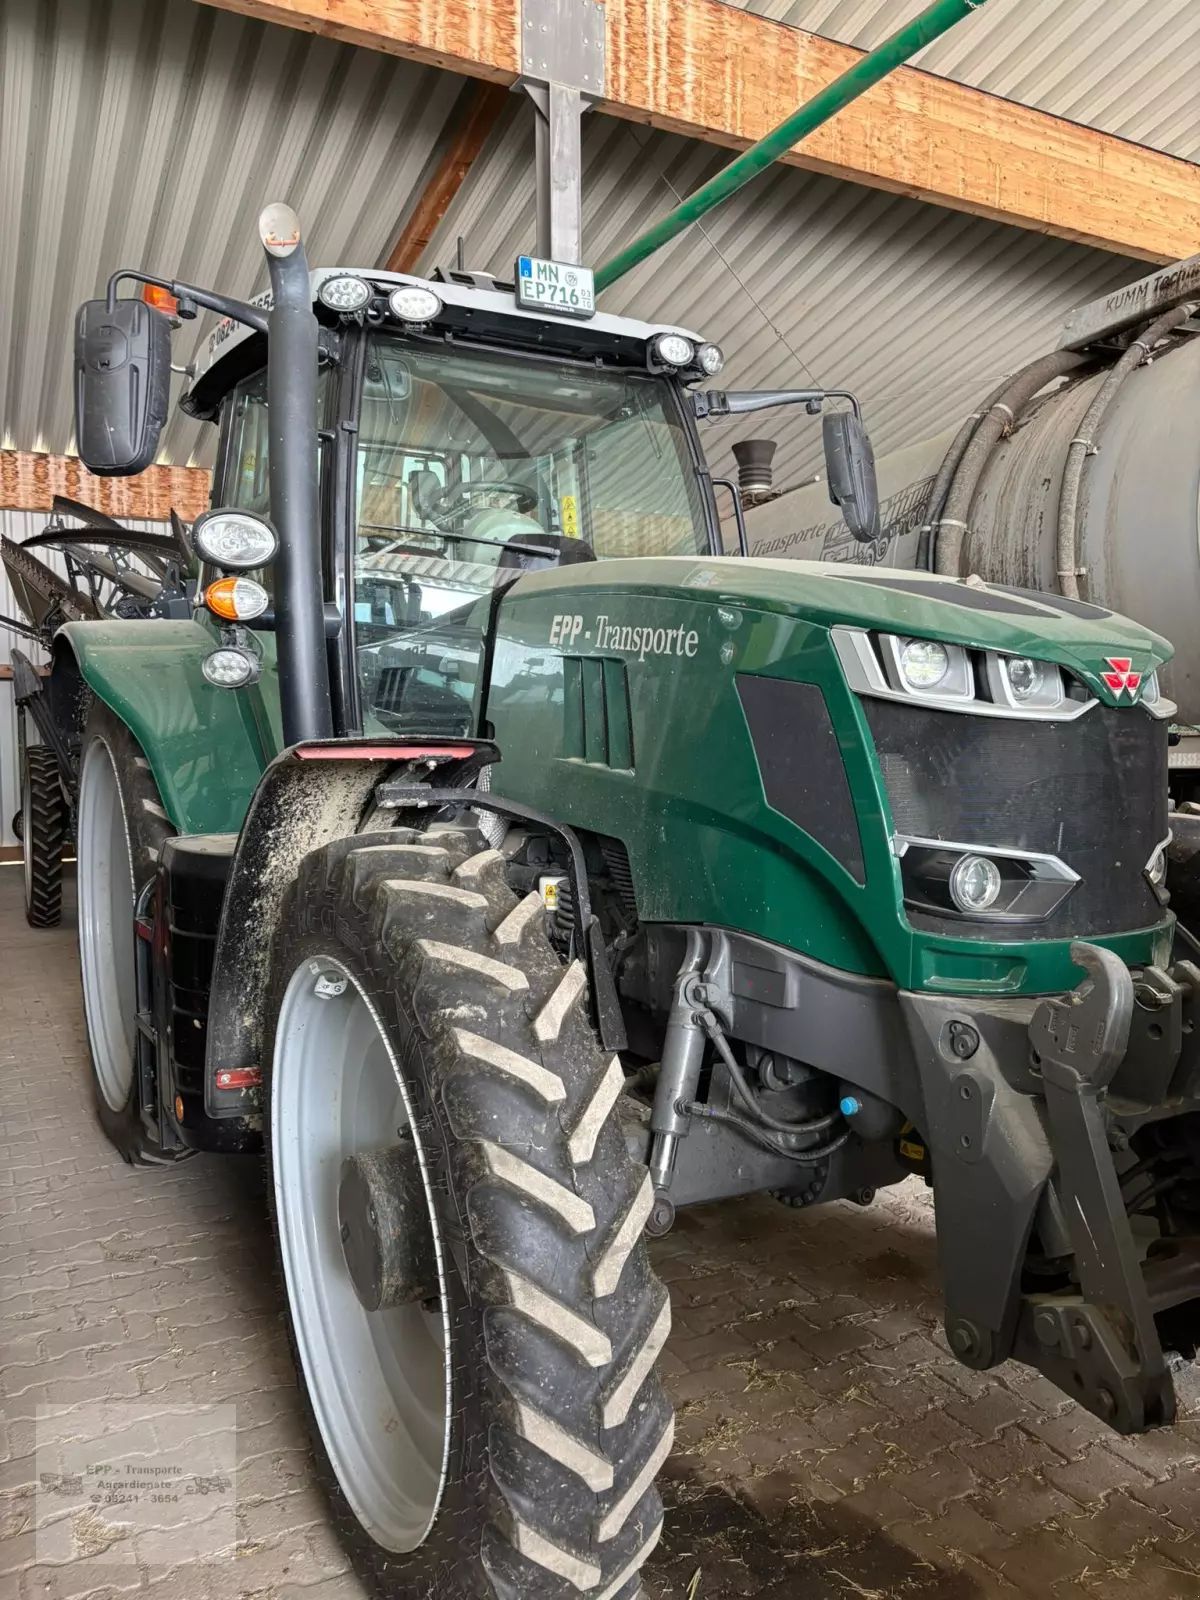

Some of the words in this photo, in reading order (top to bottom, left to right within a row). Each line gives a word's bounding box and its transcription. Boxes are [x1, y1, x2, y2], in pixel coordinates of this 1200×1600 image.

[537, 262, 559, 283] MN
[1106, 281, 1149, 313] KUMM
[752, 523, 826, 557] Transporte
[549, 615, 583, 646] EPP
[595, 615, 699, 662] Transporte
